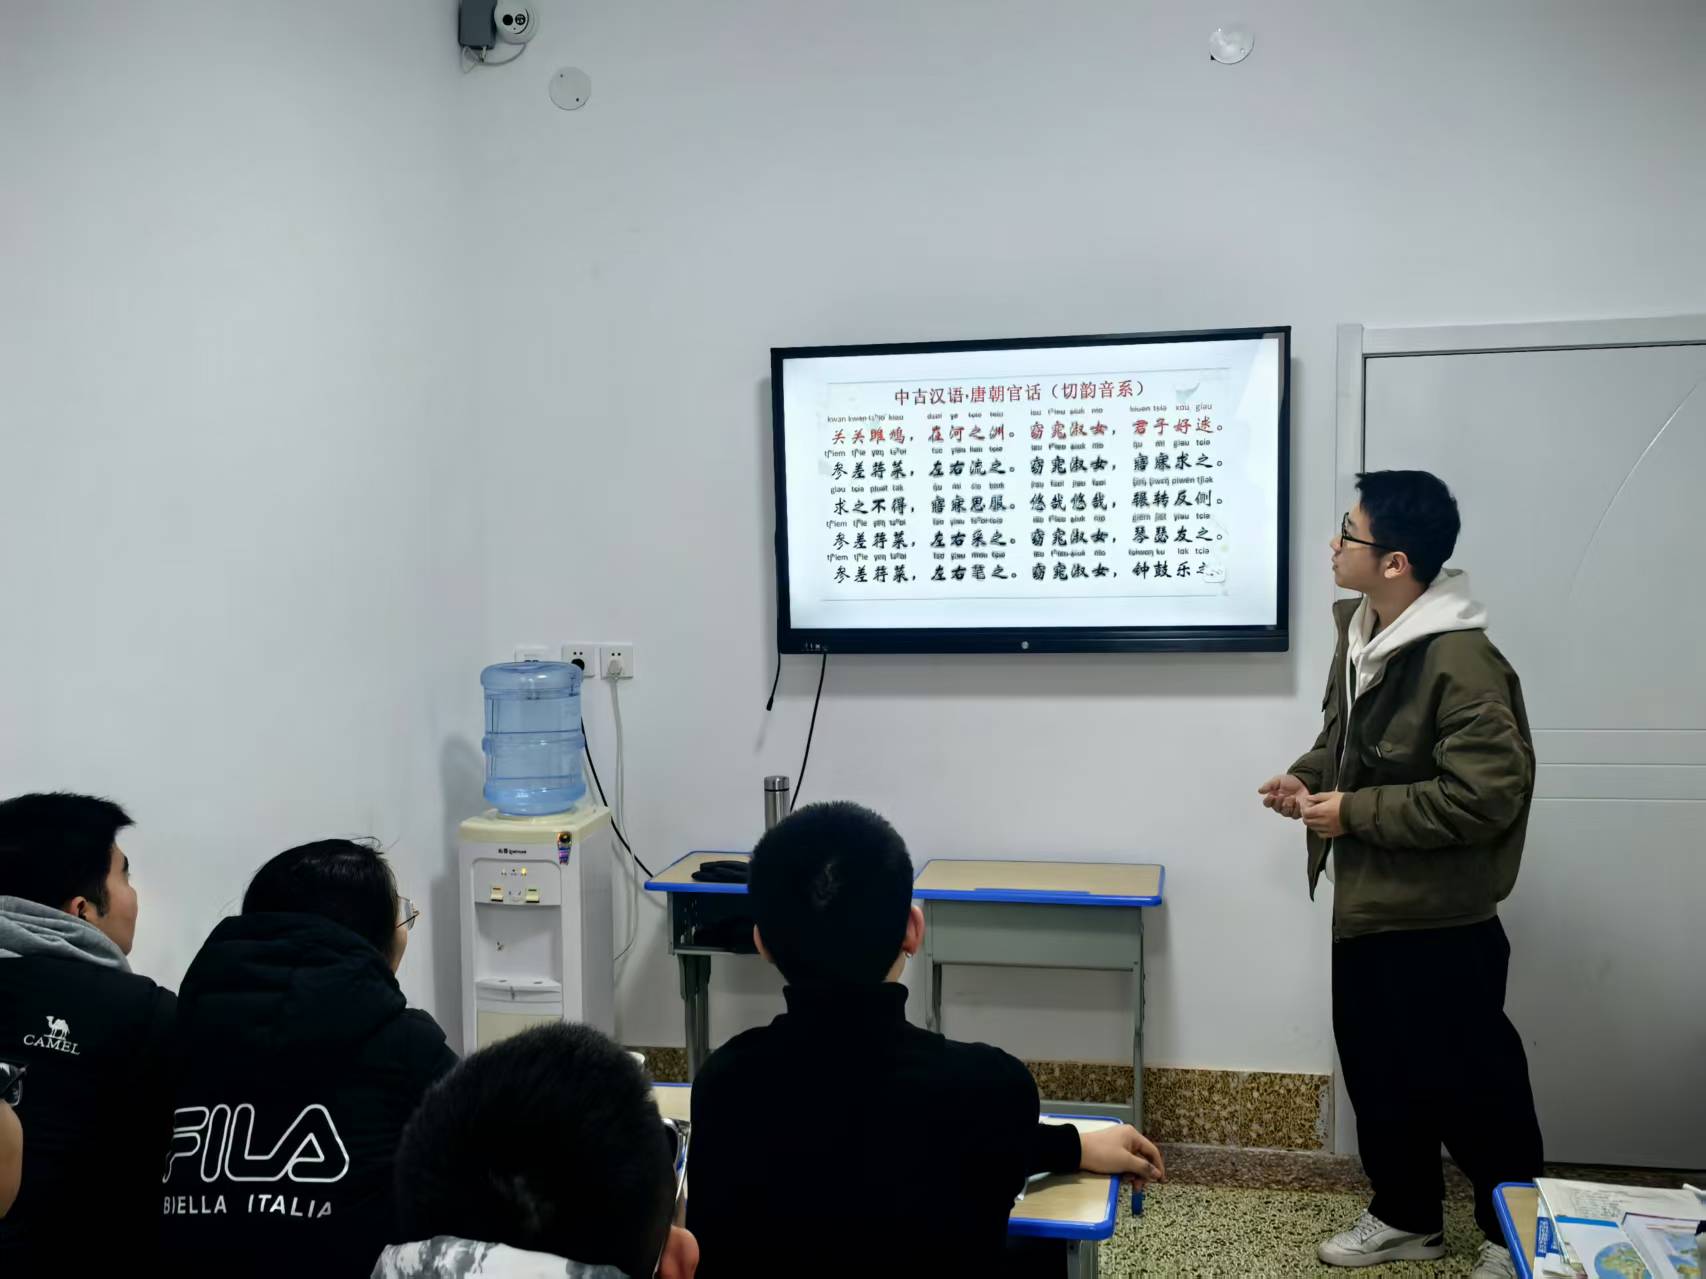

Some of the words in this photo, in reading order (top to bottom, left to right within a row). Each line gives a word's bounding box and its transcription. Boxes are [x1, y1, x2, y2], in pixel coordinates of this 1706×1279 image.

[23, 1034, 81, 1056] CAMEL
[162, 1103, 350, 1184] FILA
[163, 1195, 228, 1216] BIELLA
[247, 1194, 333, 1219] ITALIA
